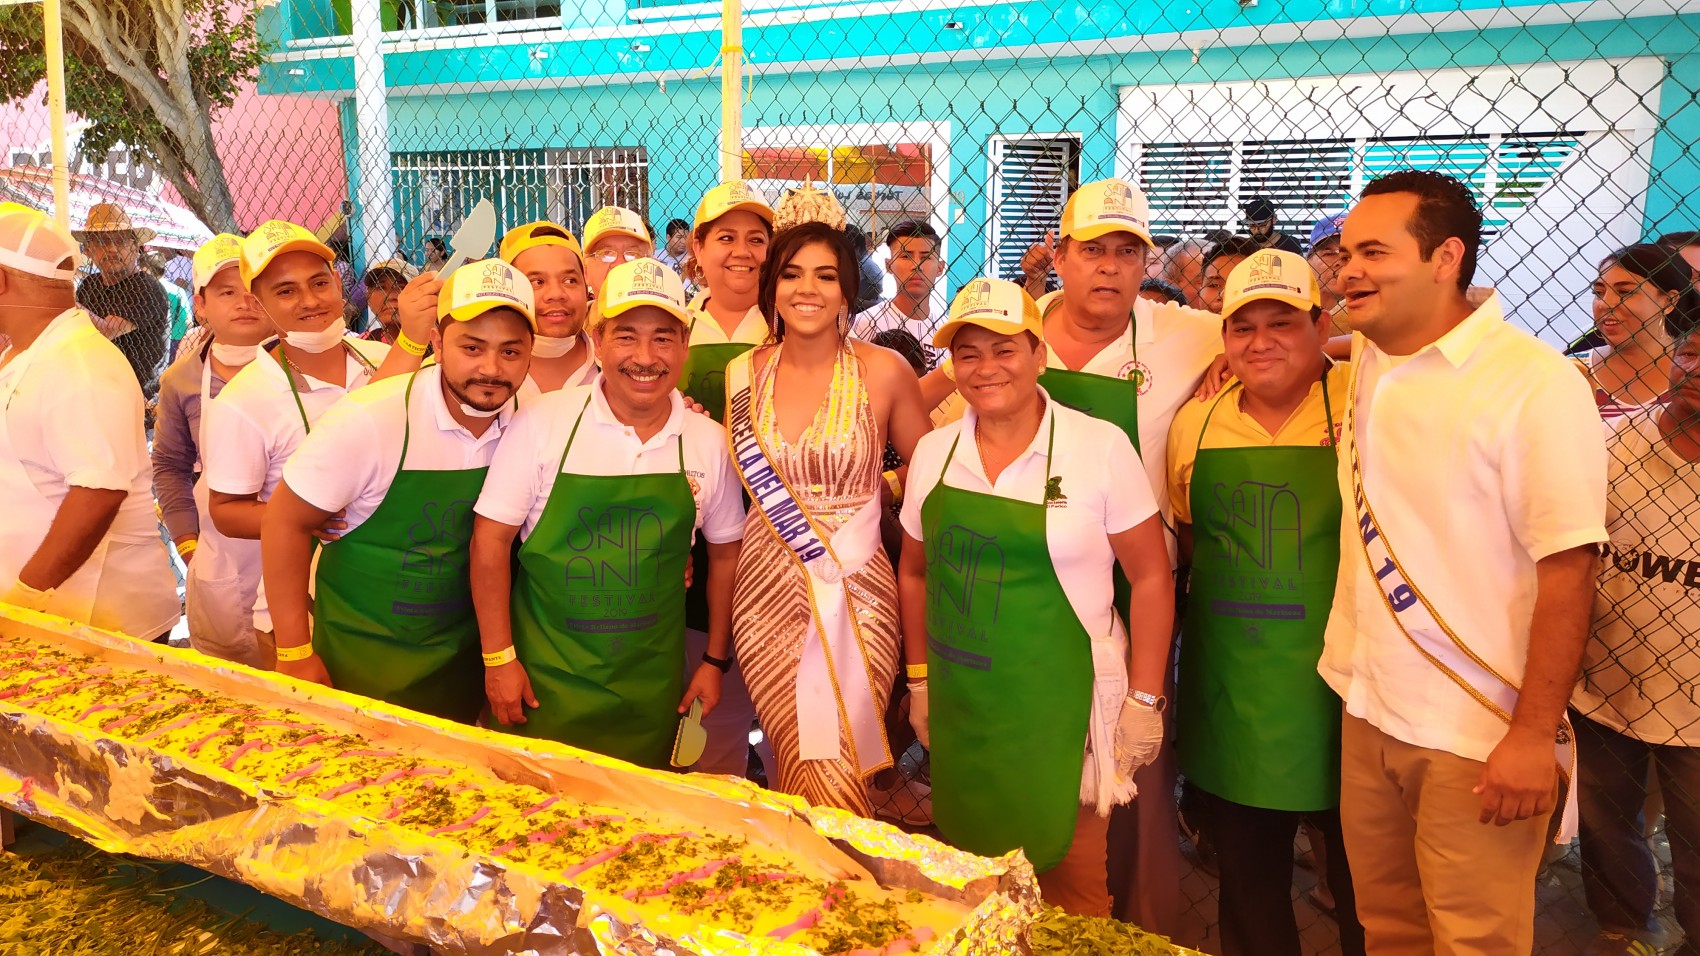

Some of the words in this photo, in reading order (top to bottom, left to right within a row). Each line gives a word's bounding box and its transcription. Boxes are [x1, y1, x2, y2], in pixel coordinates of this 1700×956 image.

[731, 386, 765, 472] DONCELLA
[746, 465, 786, 506] DEL
[766, 497, 811, 545] MAR
[1208, 480, 1302, 571] SANTA
[402, 546, 462, 576] AN
[566, 505, 663, 587] SANTA
[794, 537, 826, 563] 19
[565, 548, 663, 587] ANA
[1376, 557, 1417, 613] 19
[569, 592, 656, 608] FESTIVAL
[604, 607, 628, 618] 2019
